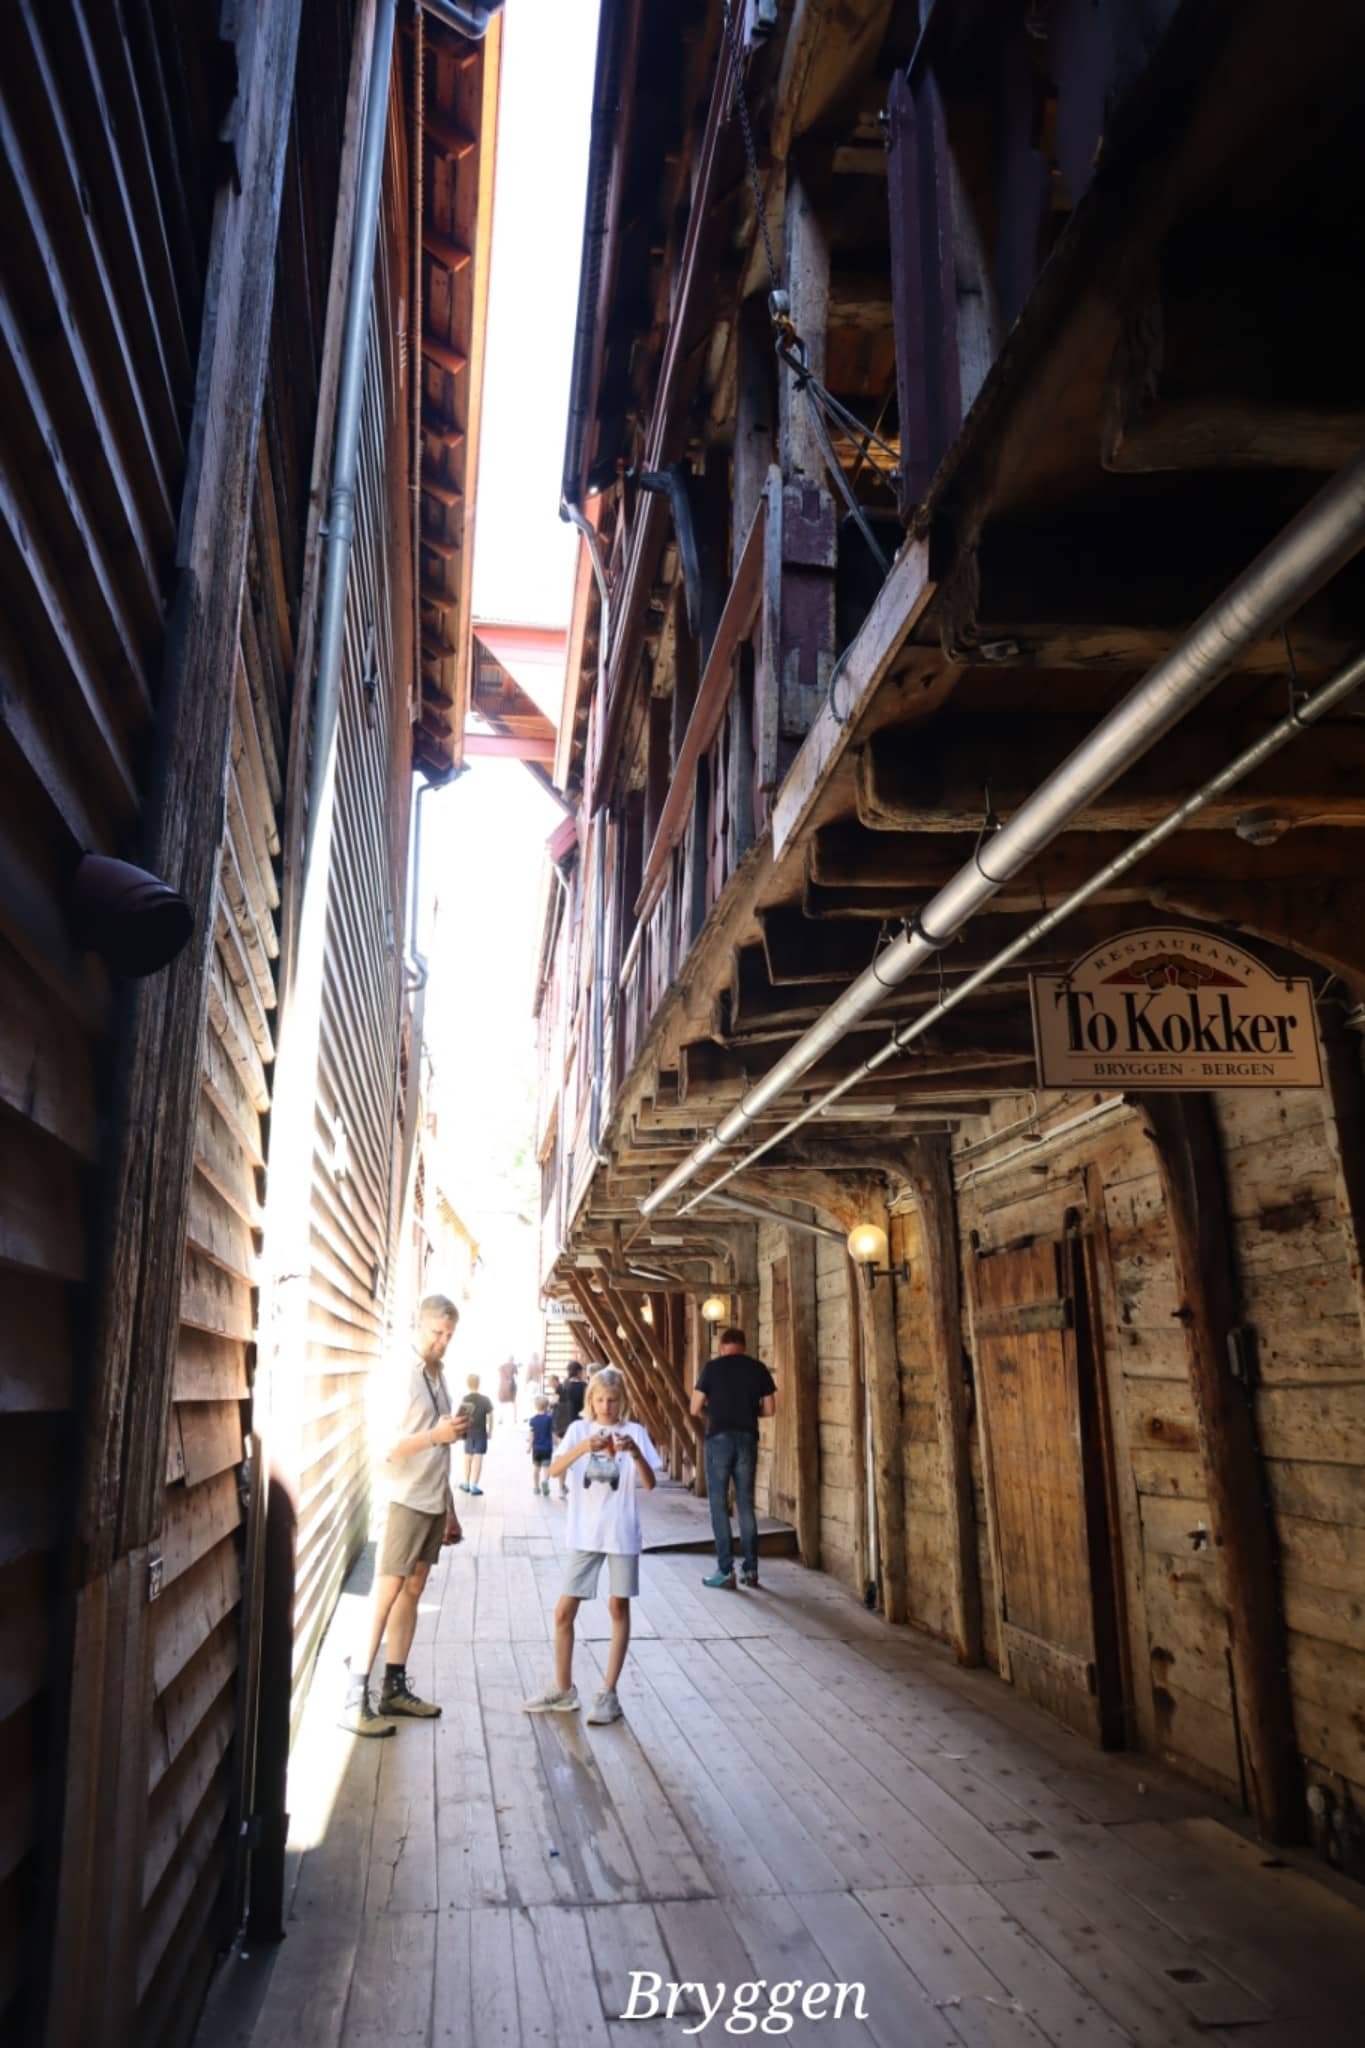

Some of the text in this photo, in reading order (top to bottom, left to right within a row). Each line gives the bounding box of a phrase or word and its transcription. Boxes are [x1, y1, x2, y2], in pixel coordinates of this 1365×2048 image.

[1094, 939, 1255, 977] RESTAURANT
[1054, 991, 1298, 1054] To Kokker
[1093, 1063, 1184, 1076] BRYGGEN
[1202, 1063, 1275, 1076] BERGEN
